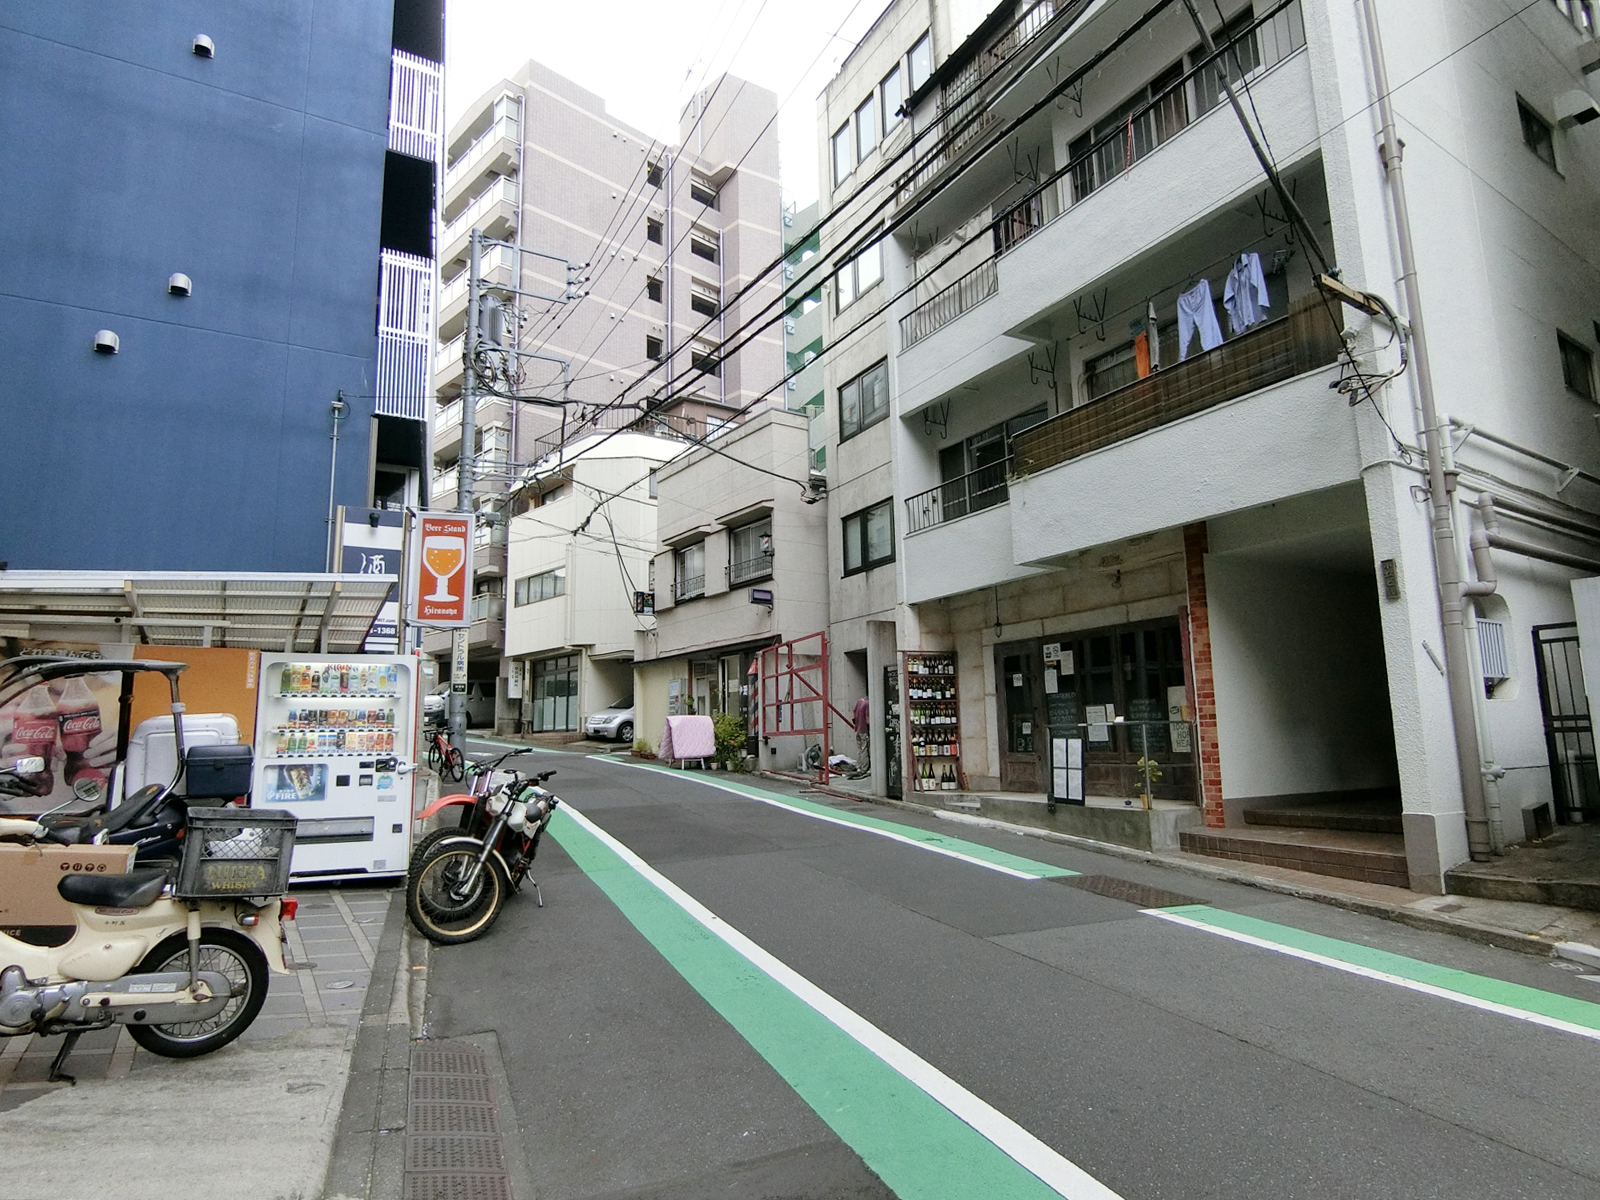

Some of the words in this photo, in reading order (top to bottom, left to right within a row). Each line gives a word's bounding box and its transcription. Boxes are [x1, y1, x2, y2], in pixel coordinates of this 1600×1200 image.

[424, 523, 442, 532] Beer
[443, 524, 466, 533] Stand
[424, 605, 458, 616] Hiranoya
[456, 633, 465, 672] セントラル病院
[275, 792, 297, 800] FIRE
[206, 865, 267, 880] NIKKA
[211, 881, 258, 890] WHISKY
